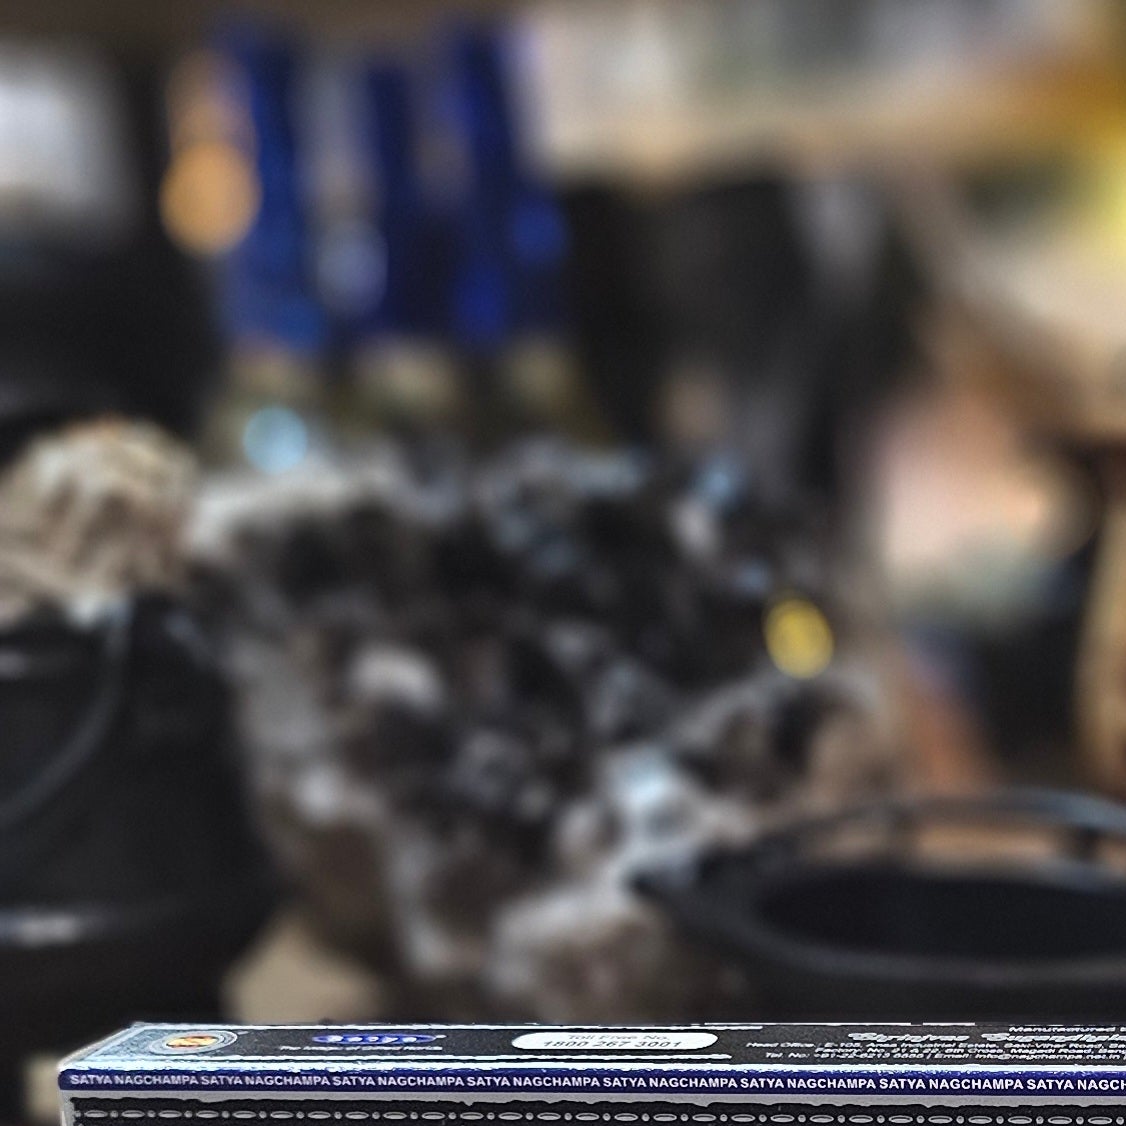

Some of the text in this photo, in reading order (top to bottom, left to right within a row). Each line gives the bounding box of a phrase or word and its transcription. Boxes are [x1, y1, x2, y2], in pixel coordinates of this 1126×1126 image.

[543, 1040, 589, 1048] 1800
[70, 1074, 112, 1085] SATYA
[114, 1073, 198, 1085] NAGCHAMPA
[201, 1073, 242, 1085] SATYA
[245, 1074, 330, 1086] NAGCHAMPA
[333, 1074, 375, 1086] SATYA
[378, 1075, 464, 1087] NAGCHAMPA
[467, 1076, 510, 1087] SATYA
[513, 1076, 600, 1087] NAGCHAMPA
[603, 1076, 646, 1088] SATYA
[650, 1077, 737, 1089] NAGCHAMPA
[741, 1077, 784, 1089] SATYA
[787, 1077, 876, 1090] NAGCHAMPA
[879, 1078, 926, 1090] SATYA
[929, 1078, 1023, 1090] NAGCHAMPA
[1027, 1078, 1074, 1090] SATYA
